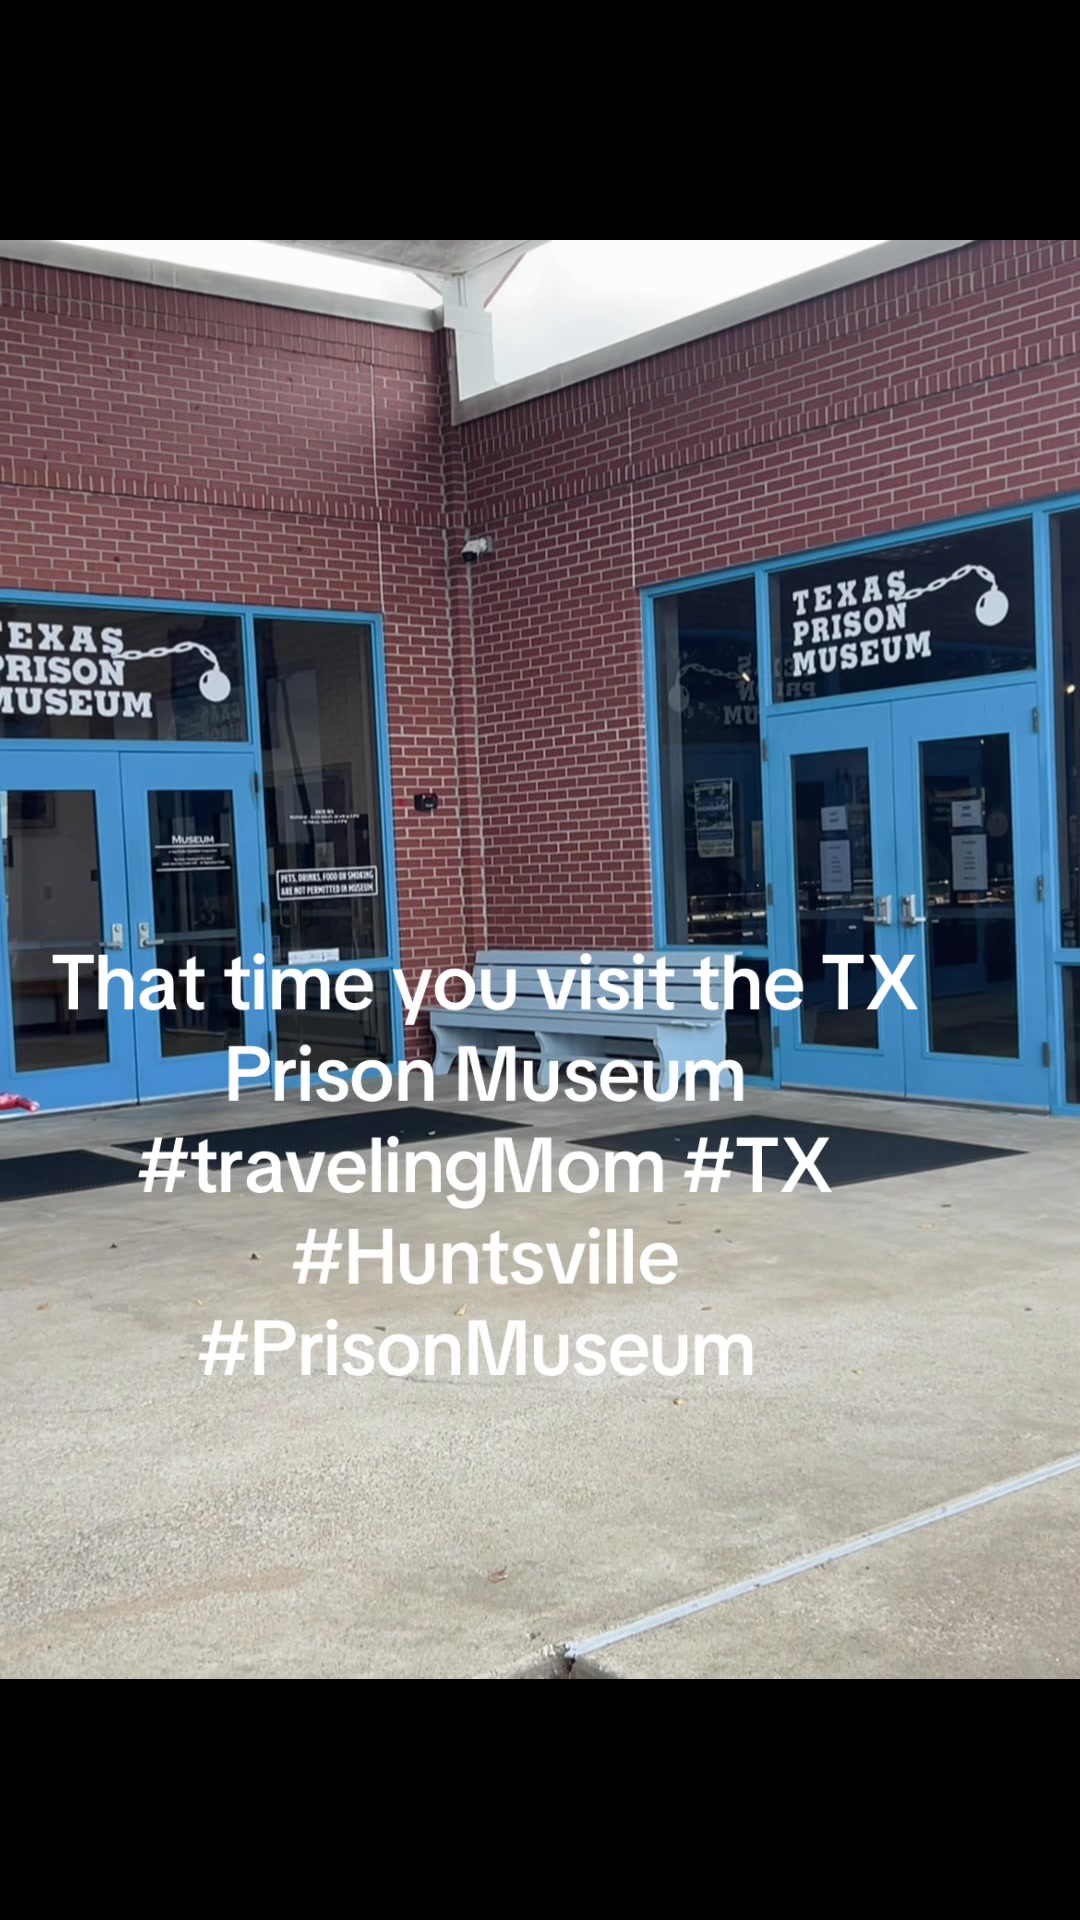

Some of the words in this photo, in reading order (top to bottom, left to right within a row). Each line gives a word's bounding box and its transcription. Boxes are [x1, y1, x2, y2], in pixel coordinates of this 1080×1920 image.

[792, 570, 907, 616] TEXAS
[0, 620, 124, 654] EXAS
[792, 602, 908, 647] PRISON
[0, 654, 125, 686] RISON
[792, 630, 932, 678] MUSEUM
[281, 887, 293, 895] ARE
[294, 886, 305, 895] NOT
[306, 883, 340, 895] PERMITTED
[341, 883, 348, 893] IN
[349, 883, 373, 892] MUSEUM
[323, 872, 338, 881] FOOD
[339, 871, 347, 880] OR
[347, 870, 374, 880] SMOKING
